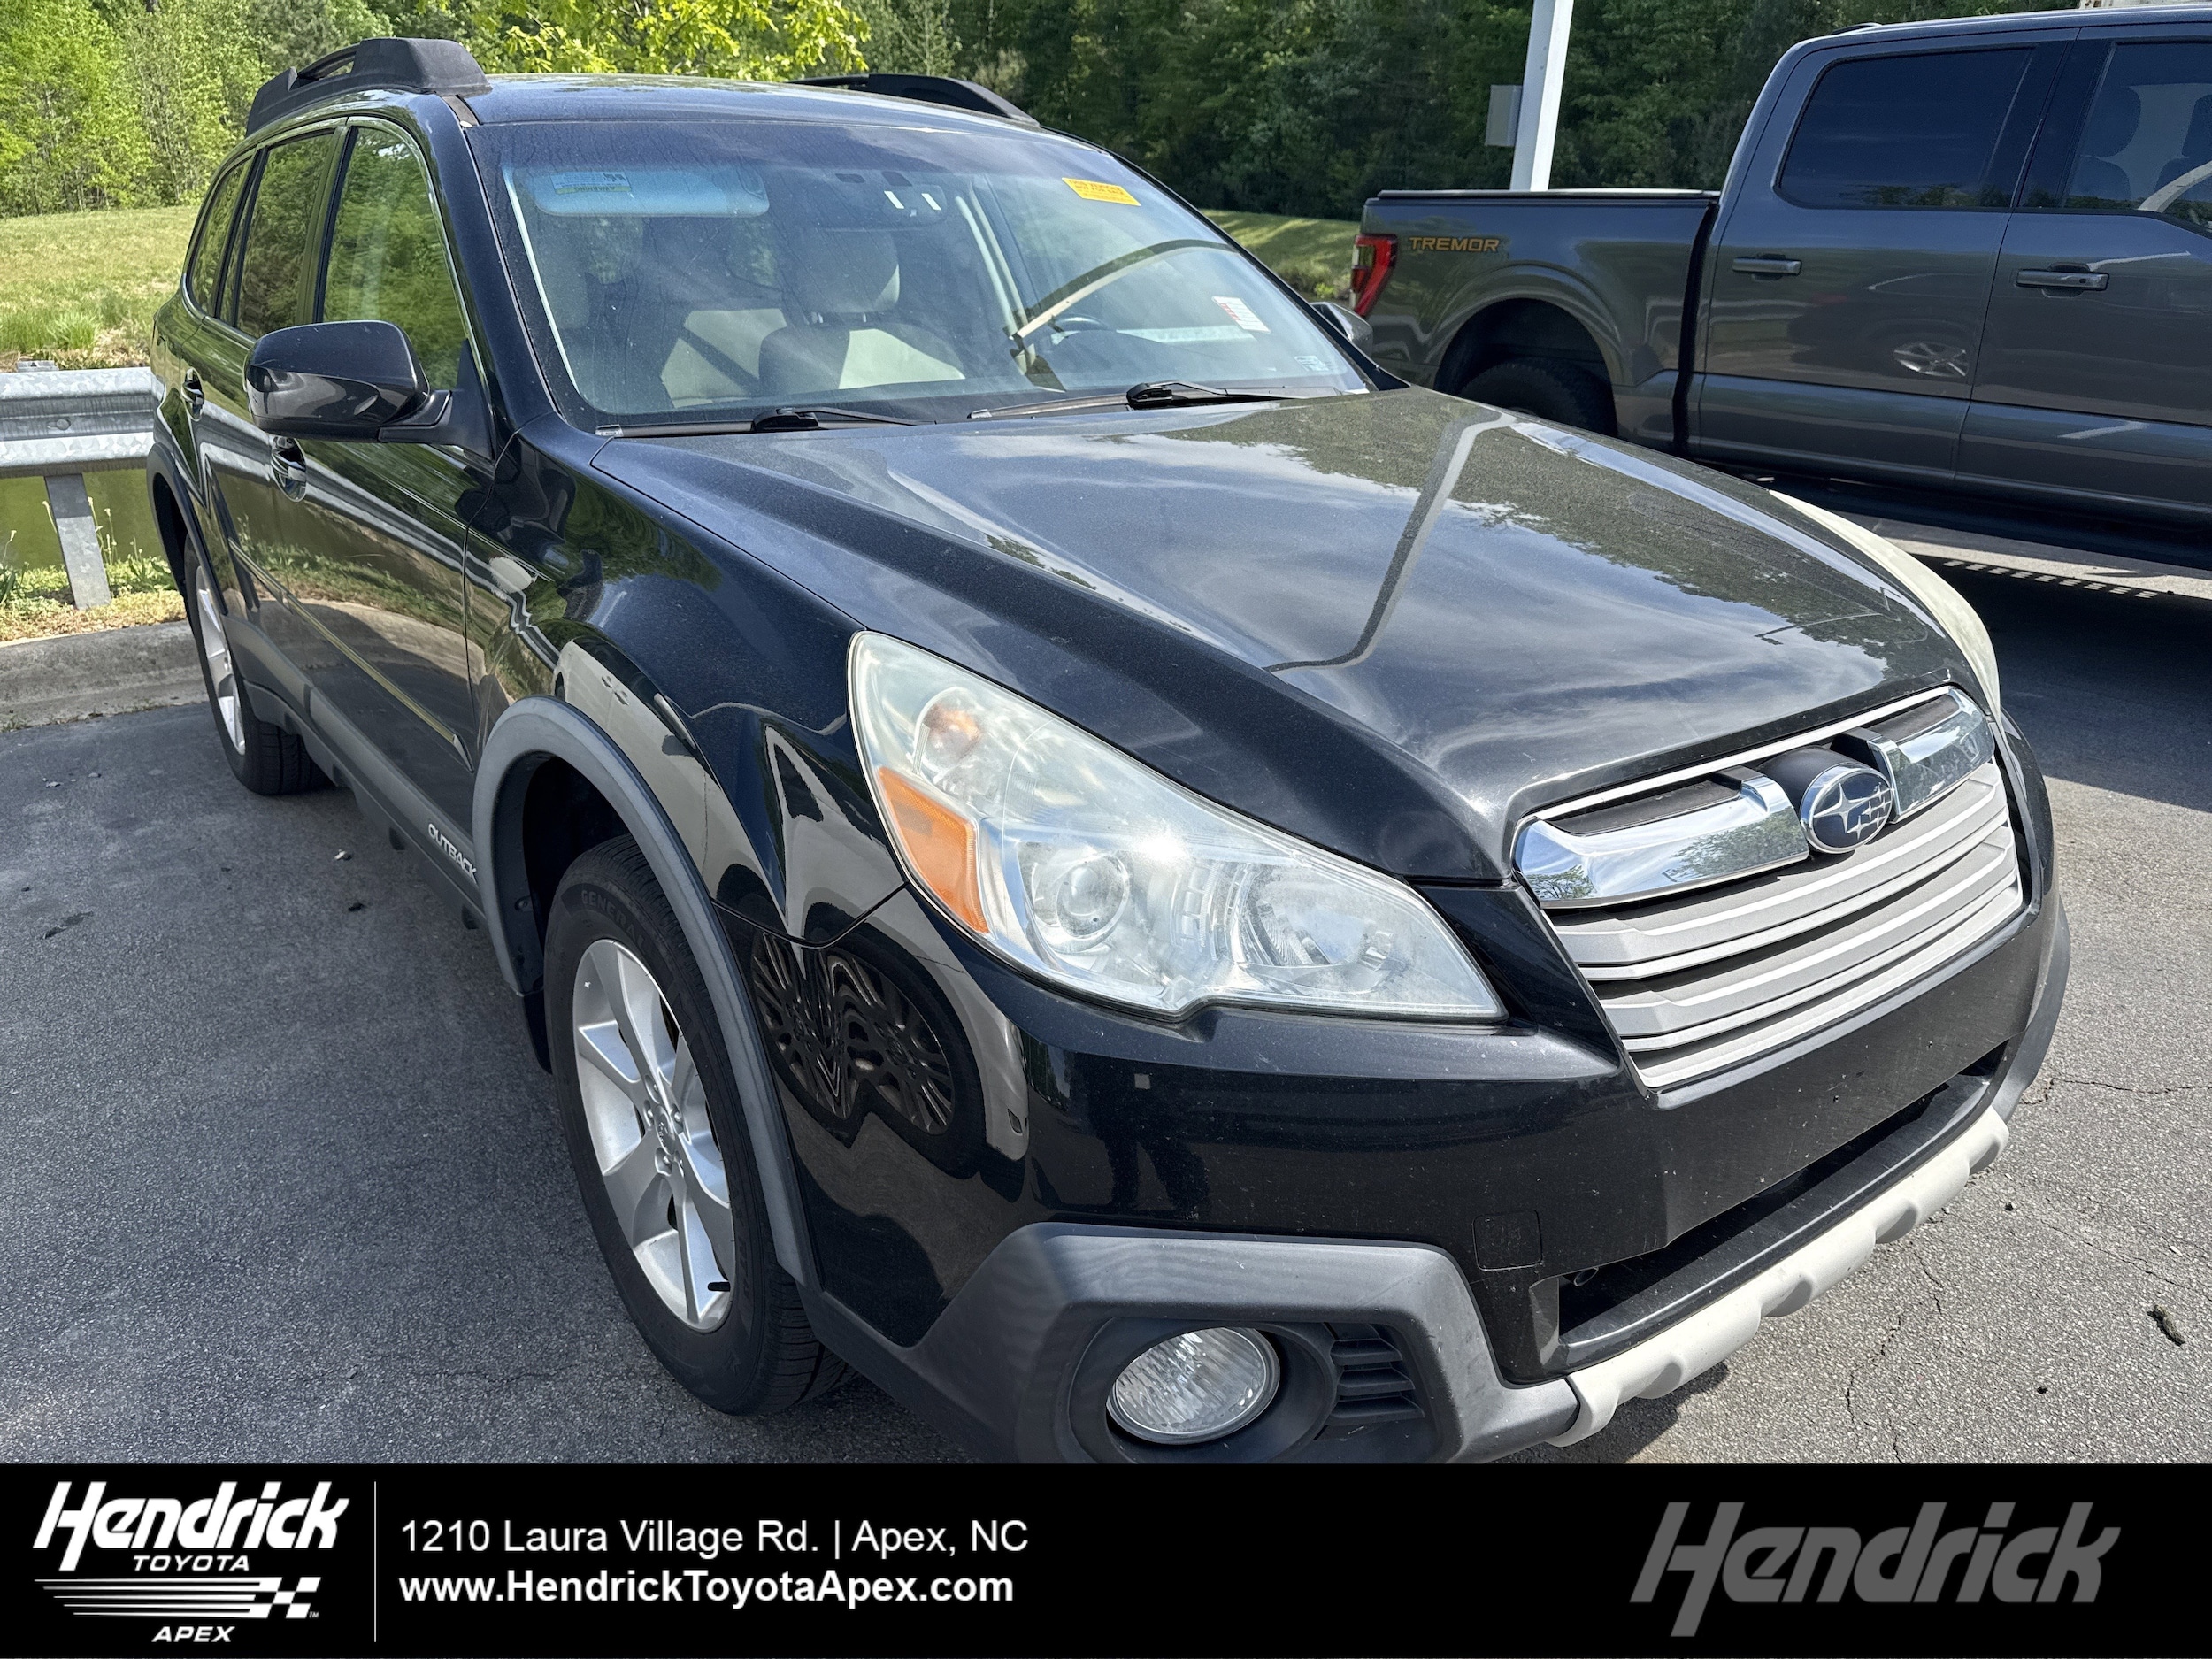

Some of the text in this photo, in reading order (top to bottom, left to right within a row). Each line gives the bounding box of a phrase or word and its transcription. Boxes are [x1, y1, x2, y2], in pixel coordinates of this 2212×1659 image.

[1409, 236, 1501, 252] TREMOR
[427, 823, 477, 885] OUTBACK
[580, 888, 646, 952] GENERAL
